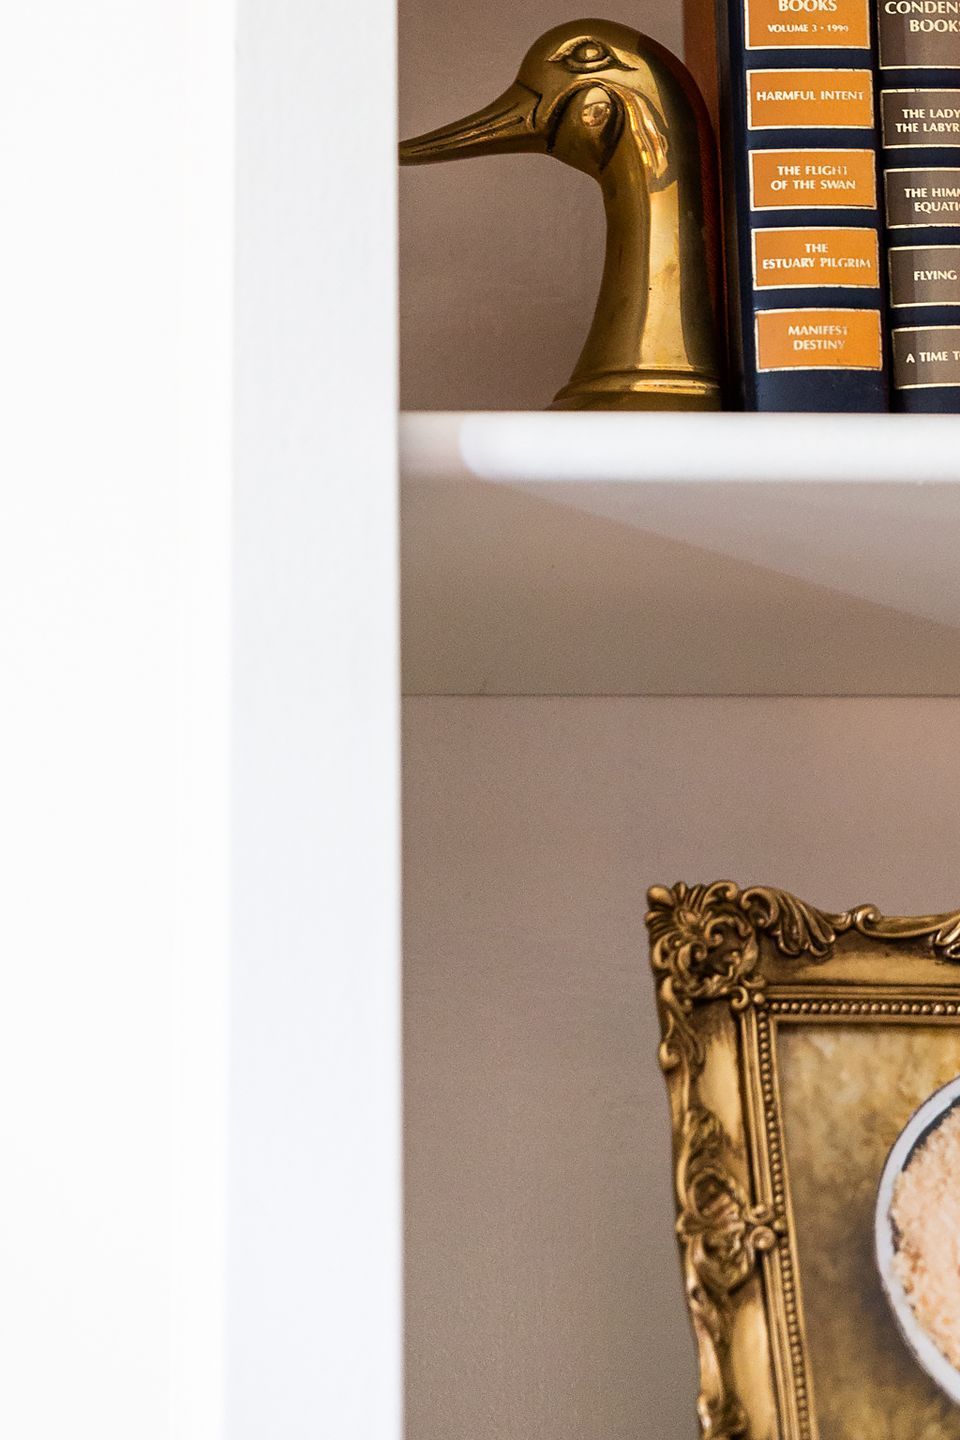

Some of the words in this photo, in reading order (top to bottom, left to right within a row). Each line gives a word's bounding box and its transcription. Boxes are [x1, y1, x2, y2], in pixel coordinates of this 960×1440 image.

[767, 24, 808, 33] VOLUME
[756, 91, 816, 101] HARMFUL
[821, 91, 864, 100] INTENT
[902, 109, 925, 119] THE
[929, 109, 960, 118] LADY
[895, 123, 919, 133] THE
[777, 165, 801, 175] THE
[805, 165, 847, 175] FLIGHT
[770, 179, 788, 191] OF
[793, 180, 815, 190] THE
[820, 179, 856, 189] SWAN
[904, 188, 928, 198] THE
[804, 243, 829, 253] THE
[762, 257, 815, 269] ESTUARY
[820, 257, 871, 268] PILGRIM
[913, 270, 957, 281] FLYING
[793, 339, 846, 350] DESTINY
[905, 353, 916, 363] A
[919, 351, 948, 362] TIME
